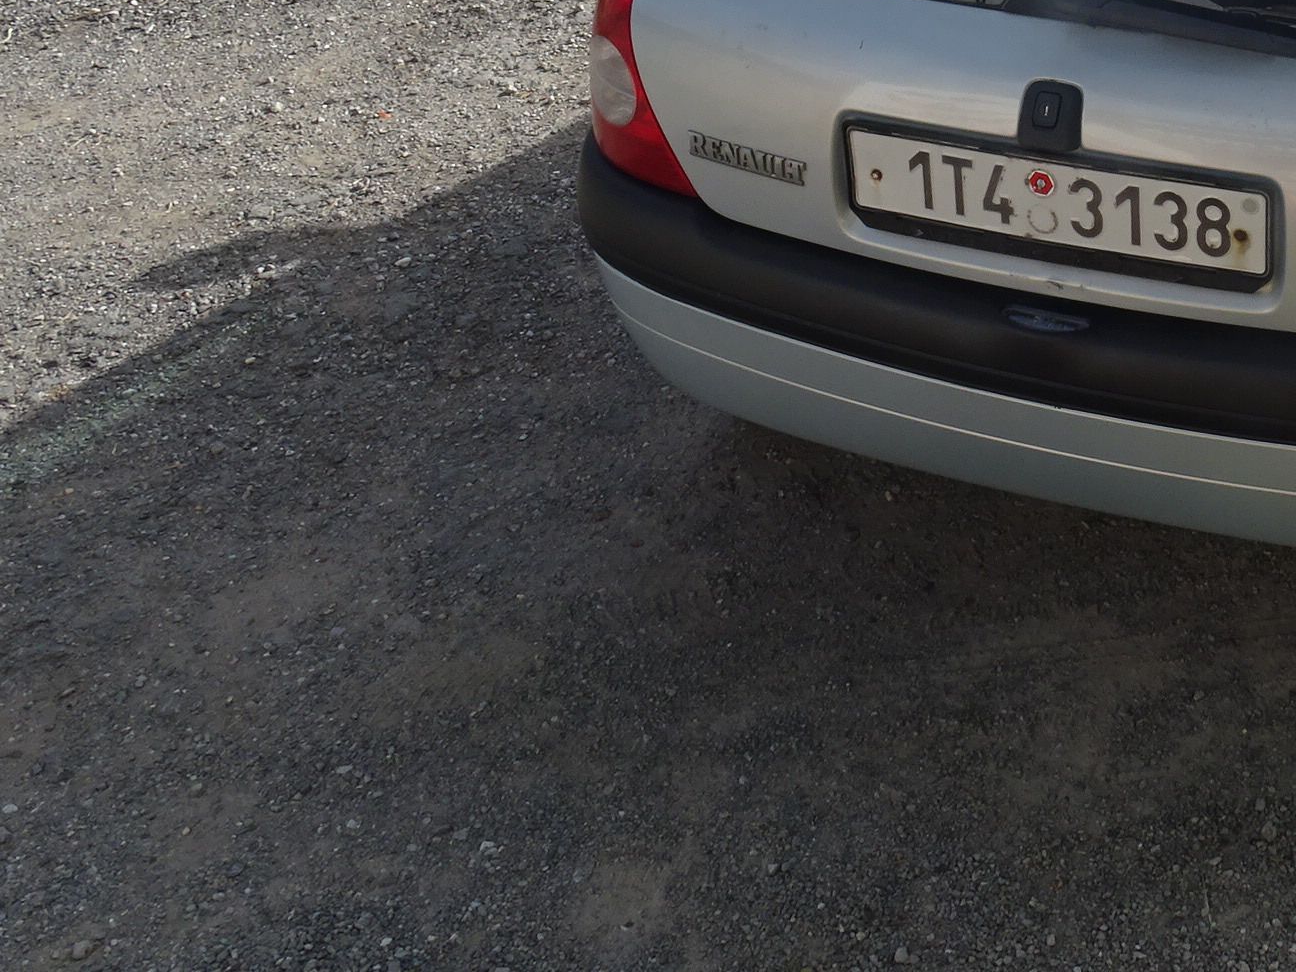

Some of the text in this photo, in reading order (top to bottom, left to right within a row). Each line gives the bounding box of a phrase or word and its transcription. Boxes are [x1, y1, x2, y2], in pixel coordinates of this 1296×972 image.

[688, 129, 807, 186] RENAULT
[909, 151, 1231, 257] 1T4 3138
